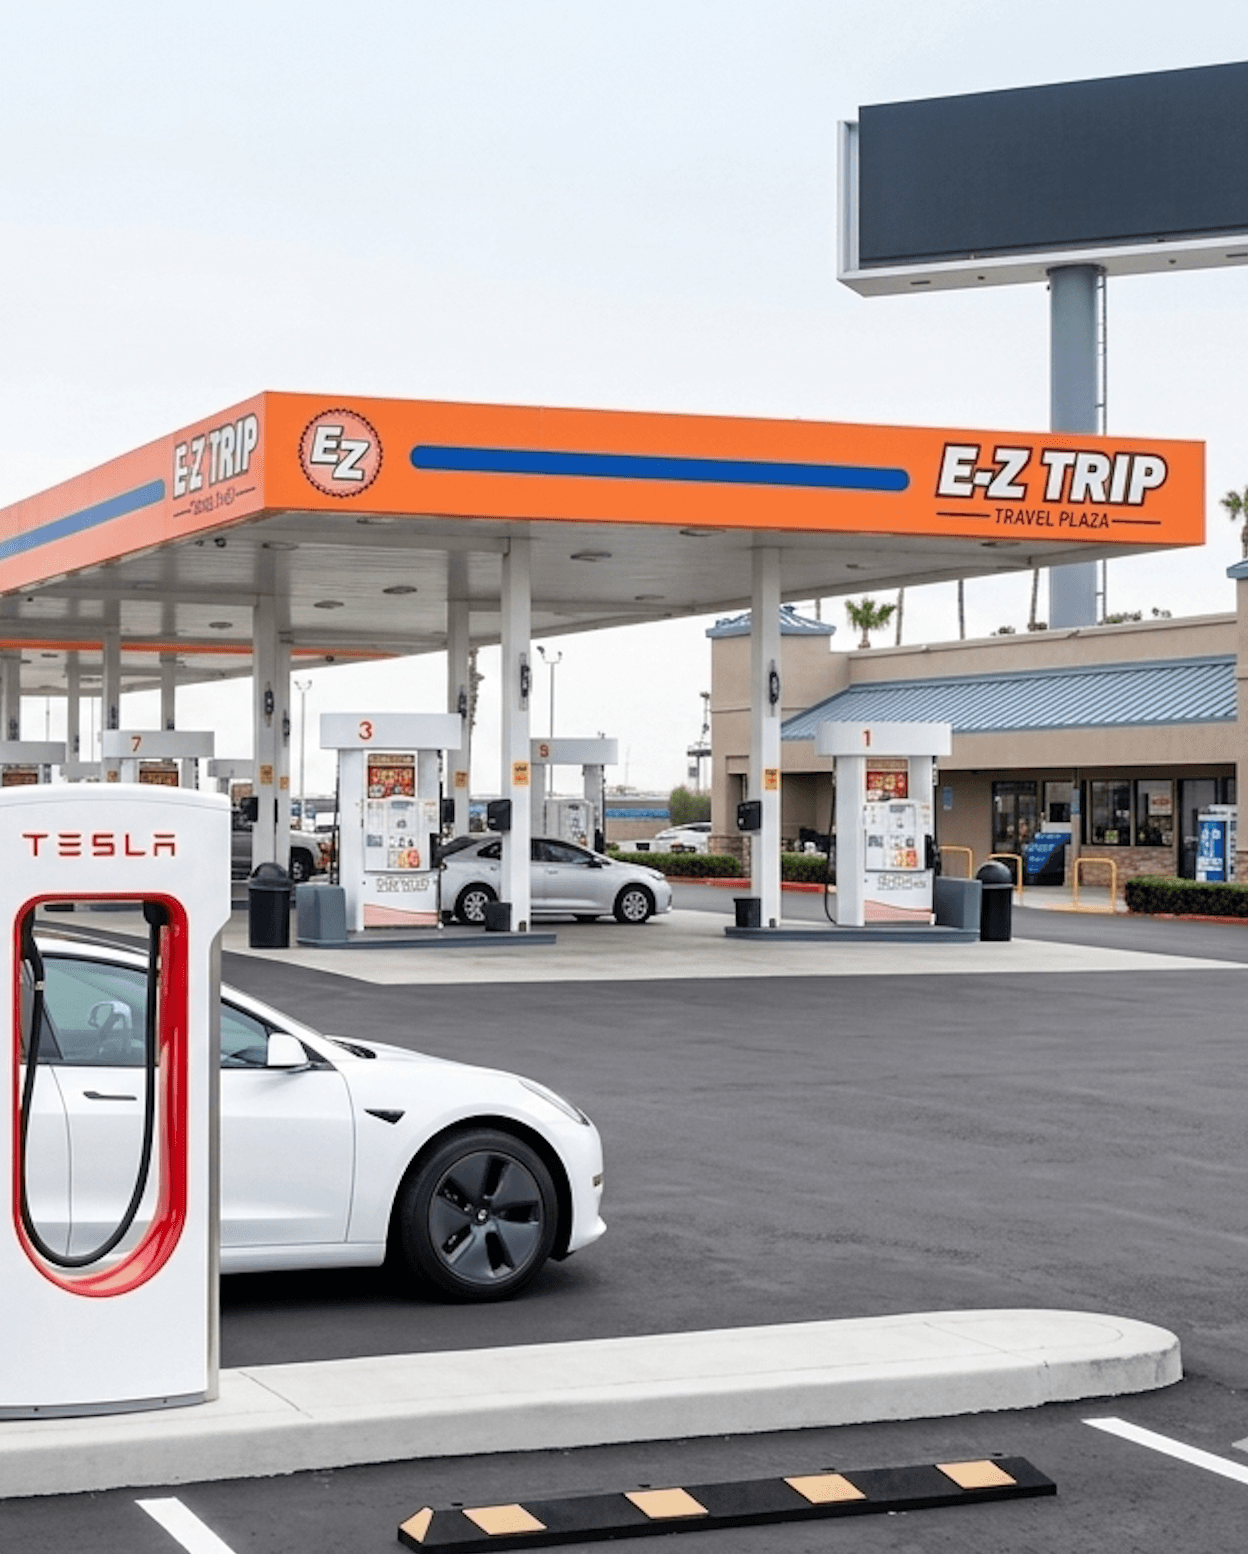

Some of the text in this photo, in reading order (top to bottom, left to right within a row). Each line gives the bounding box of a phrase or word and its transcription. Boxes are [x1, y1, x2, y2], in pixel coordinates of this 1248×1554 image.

[208, 413, 258, 487] TRIP
[935, 442, 1168, 506] E-Z TRIP
[995, 508, 1110, 529] TRAVEL PLAZA
[358, 721, 373, 740] 3
[863, 730, 871, 747] 1
[131, 735, 142, 752] 7
[21, 833, 176, 857] TESLA
